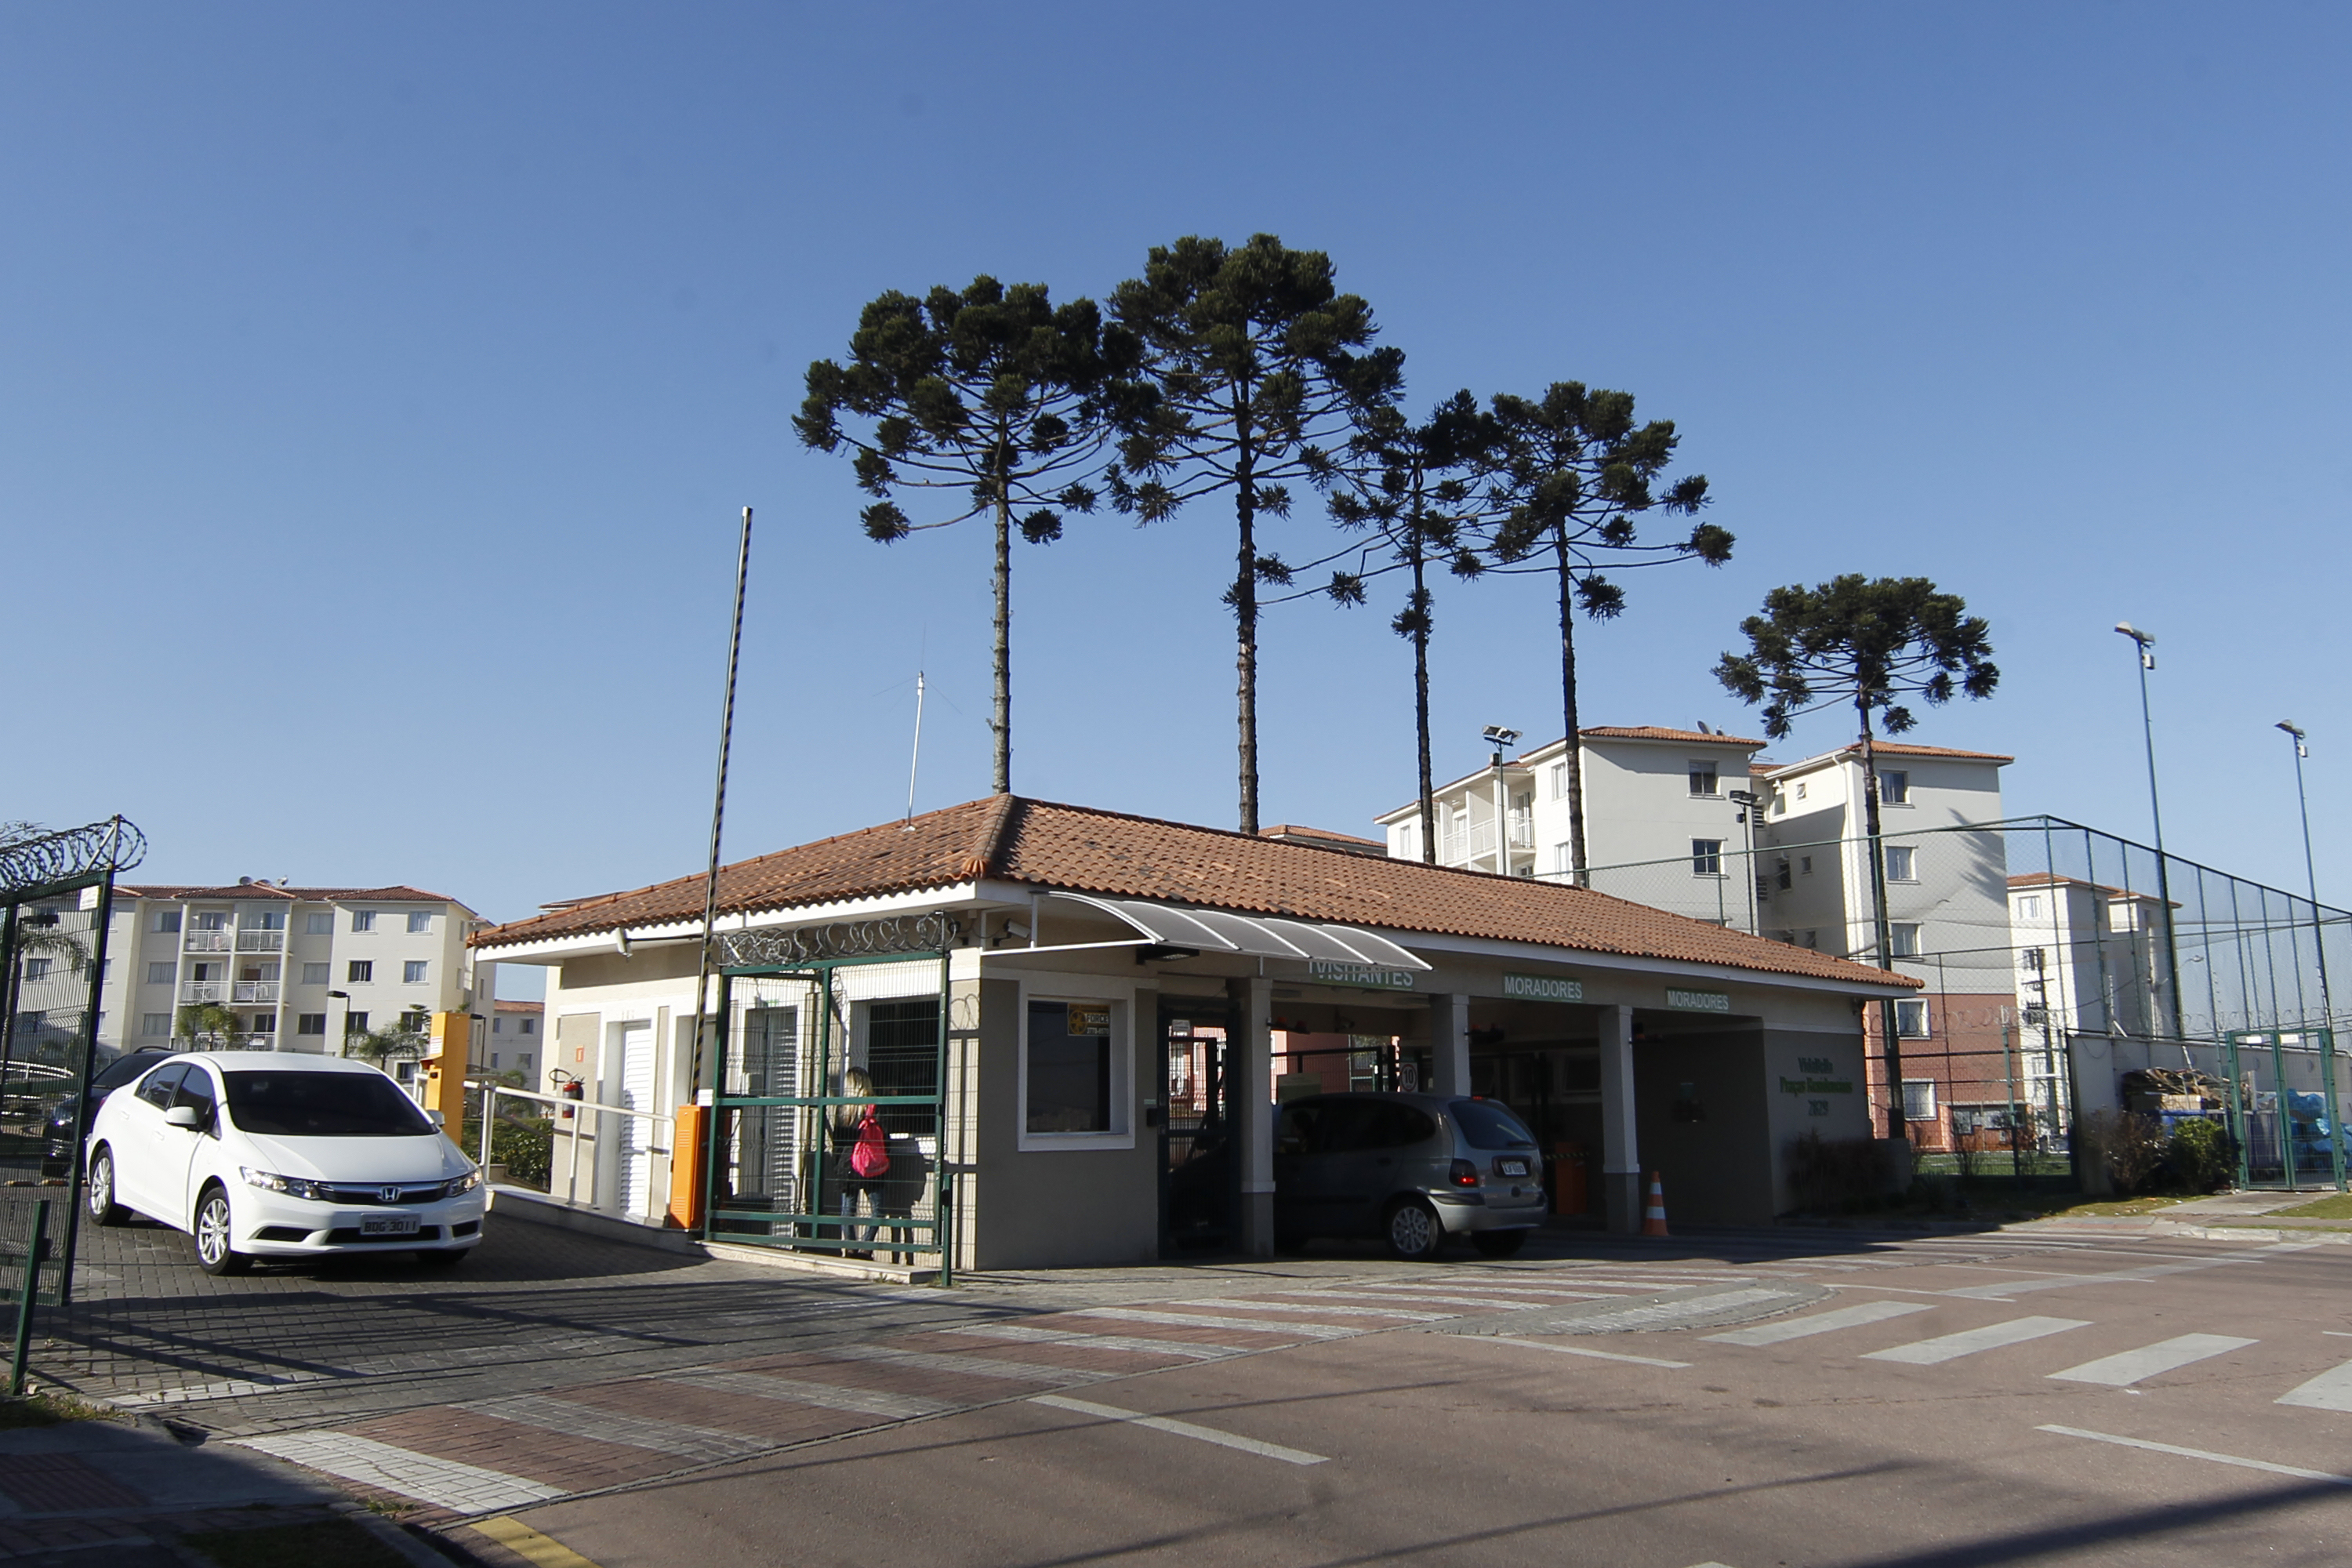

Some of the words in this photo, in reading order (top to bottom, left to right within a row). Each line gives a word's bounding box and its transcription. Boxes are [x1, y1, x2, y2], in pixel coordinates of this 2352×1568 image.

[1317, 960, 1414, 987] VISITANTES
[1504, 976, 1583, 1000] MORADORES
[1667, 990, 1729, 1011] MORADORES
[1087, 1014, 1109, 1023] FORCE
[1403, 1069, 1414, 1084] 10
